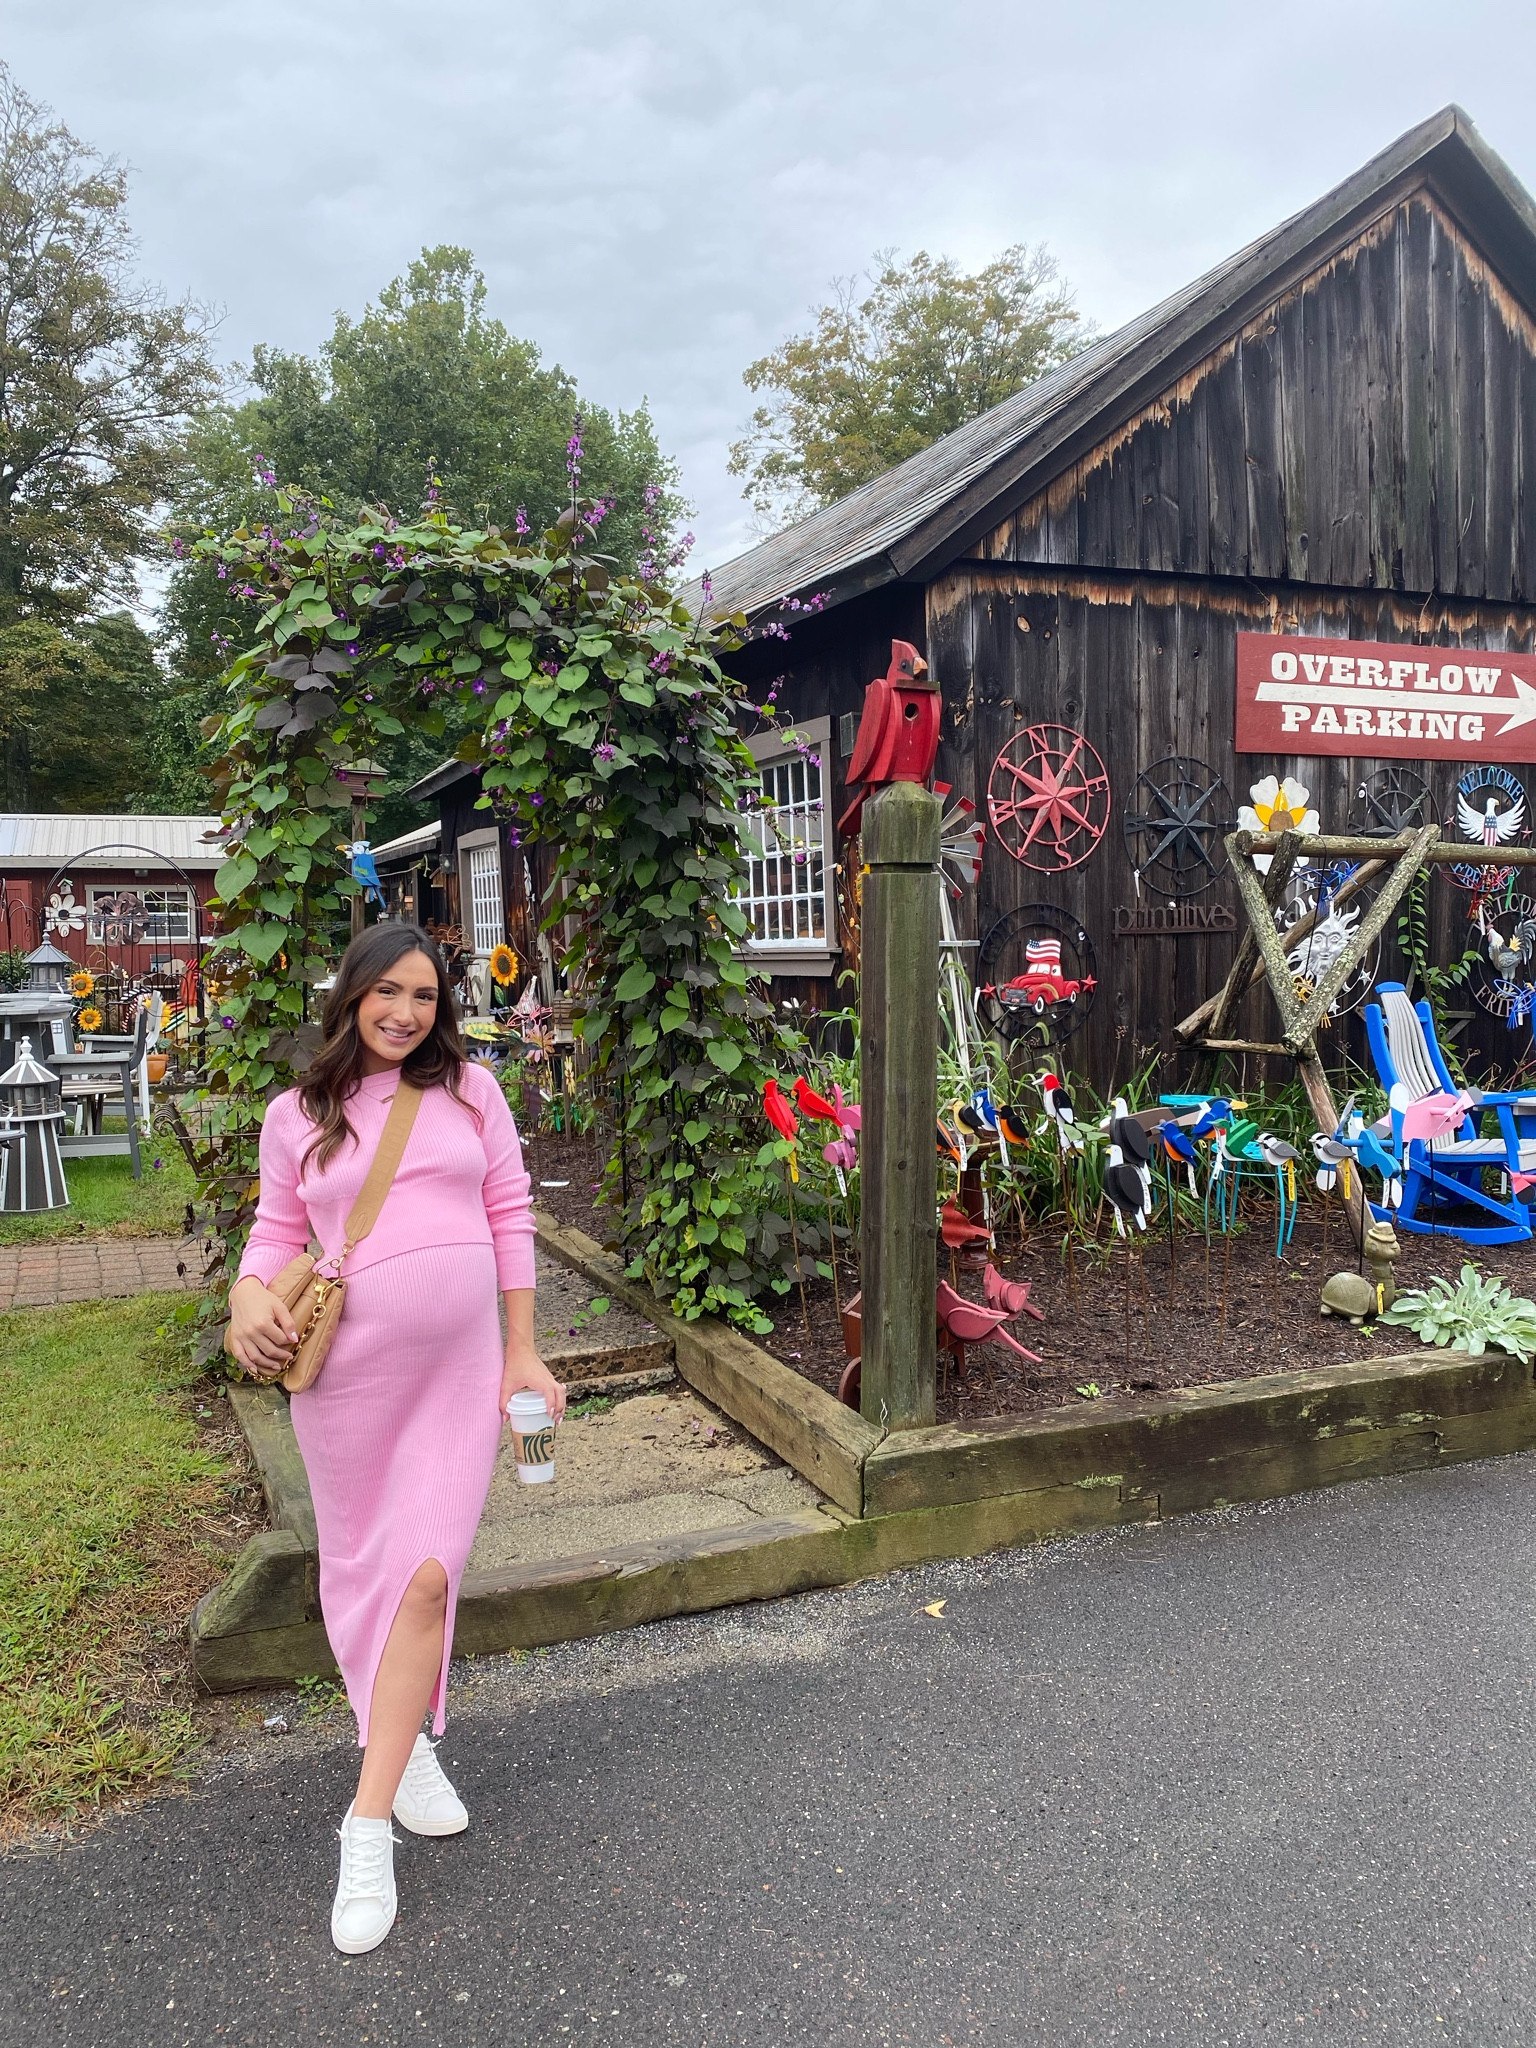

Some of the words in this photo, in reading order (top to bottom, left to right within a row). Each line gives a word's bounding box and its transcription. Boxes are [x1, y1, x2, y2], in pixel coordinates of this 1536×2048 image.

[1271, 651, 1502, 695] OVERFLOW
[1027, 726, 1050, 755] N
[1281, 704, 1486, 742] PARKING
[1085, 774, 1110, 798] E
[1457, 766, 1524, 803] WELCOME
[988, 799, 1016, 827] W
[1055, 840, 1072, 869] S
[1112, 898, 1238, 944] primitives
[1473, 893, 1536, 931] ELCO
